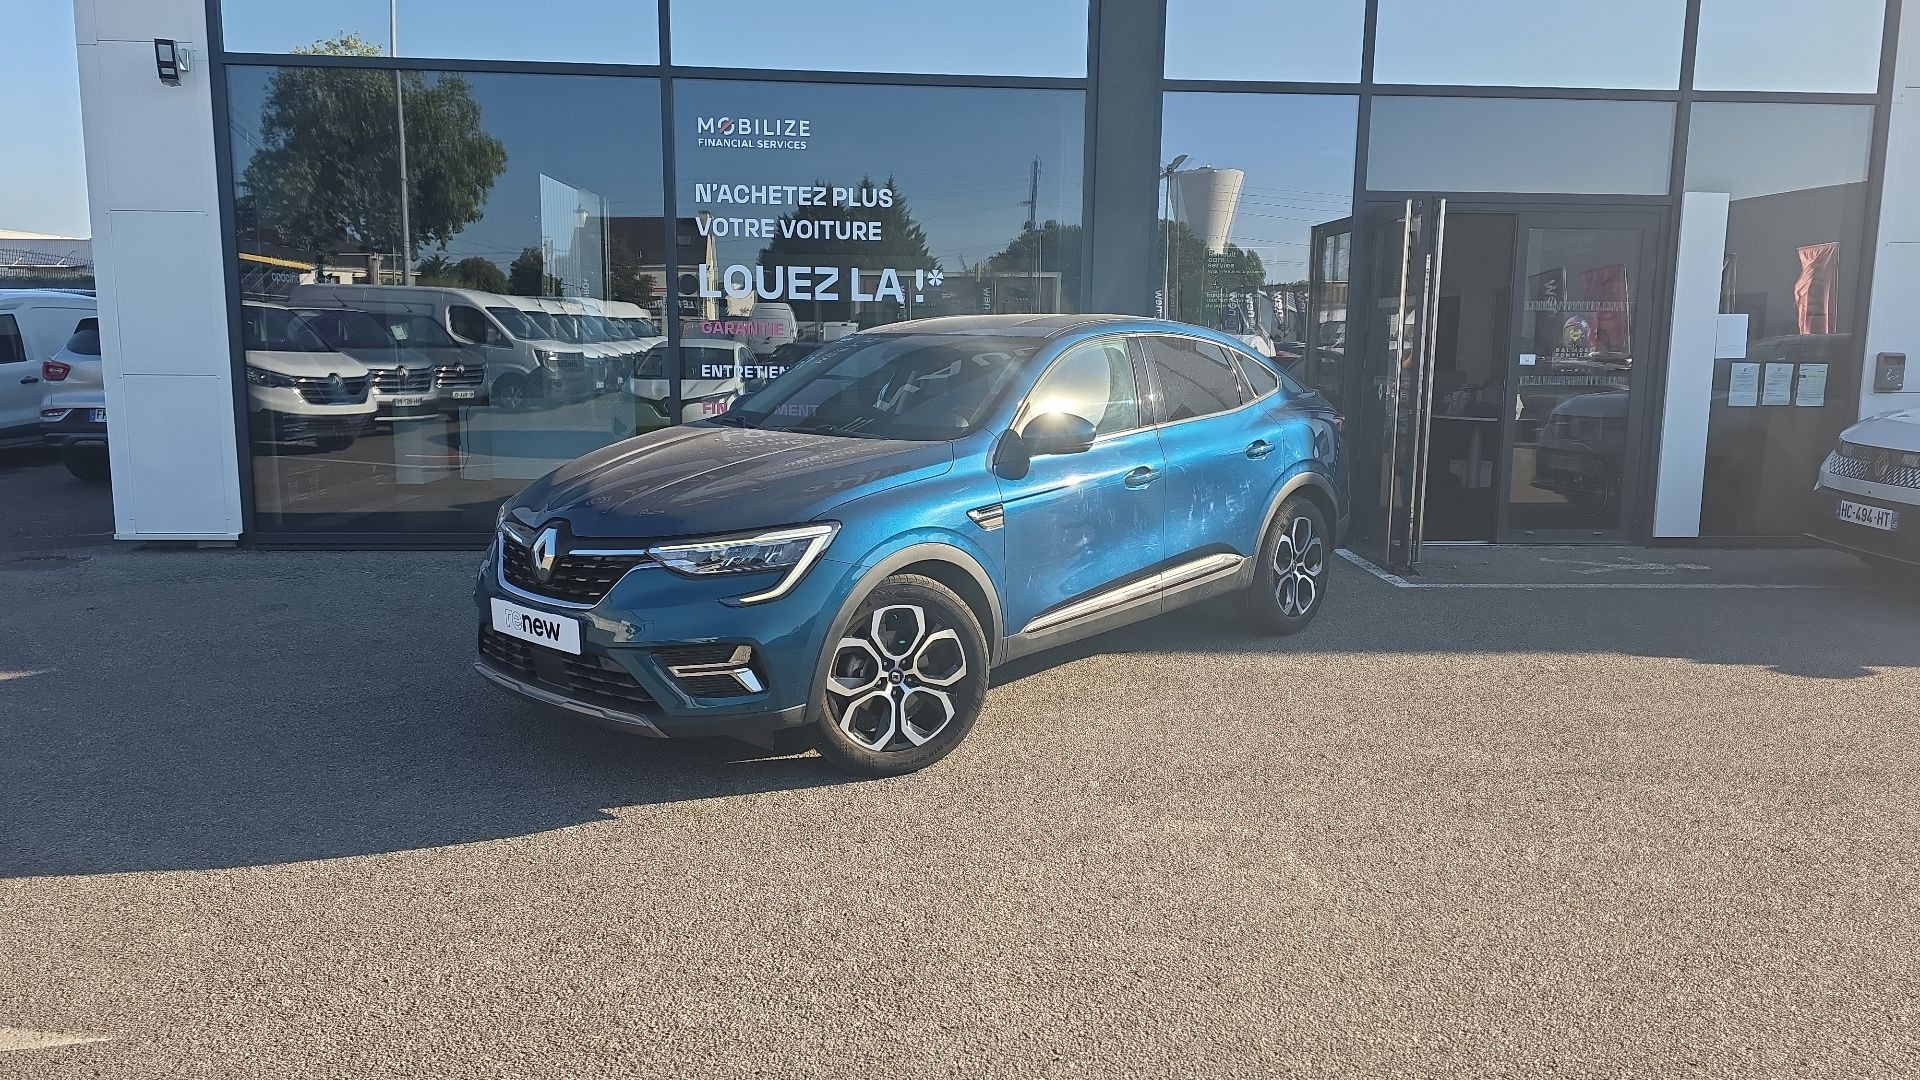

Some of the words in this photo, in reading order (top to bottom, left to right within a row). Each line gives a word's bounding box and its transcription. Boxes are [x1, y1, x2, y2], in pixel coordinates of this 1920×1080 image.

[697, 116, 810, 137] MOBILIZE
[698, 138, 755, 149] FINANCIAL
[756, 140, 807, 150] SERVICES
[695, 183, 827, 207] N'ACHETEZ
[832, 187, 893, 208] PLUS
[695, 216, 775, 238] VOTRE
[780, 219, 882, 241] VOITURE
[699, 263, 839, 301] LOUEZ
[851, 267, 901, 303] LA
[701, 320, 784, 336] GARANTIE
[1840, 502, 1890, 528] HC-494-HT
[505, 608, 560, 642] renew
